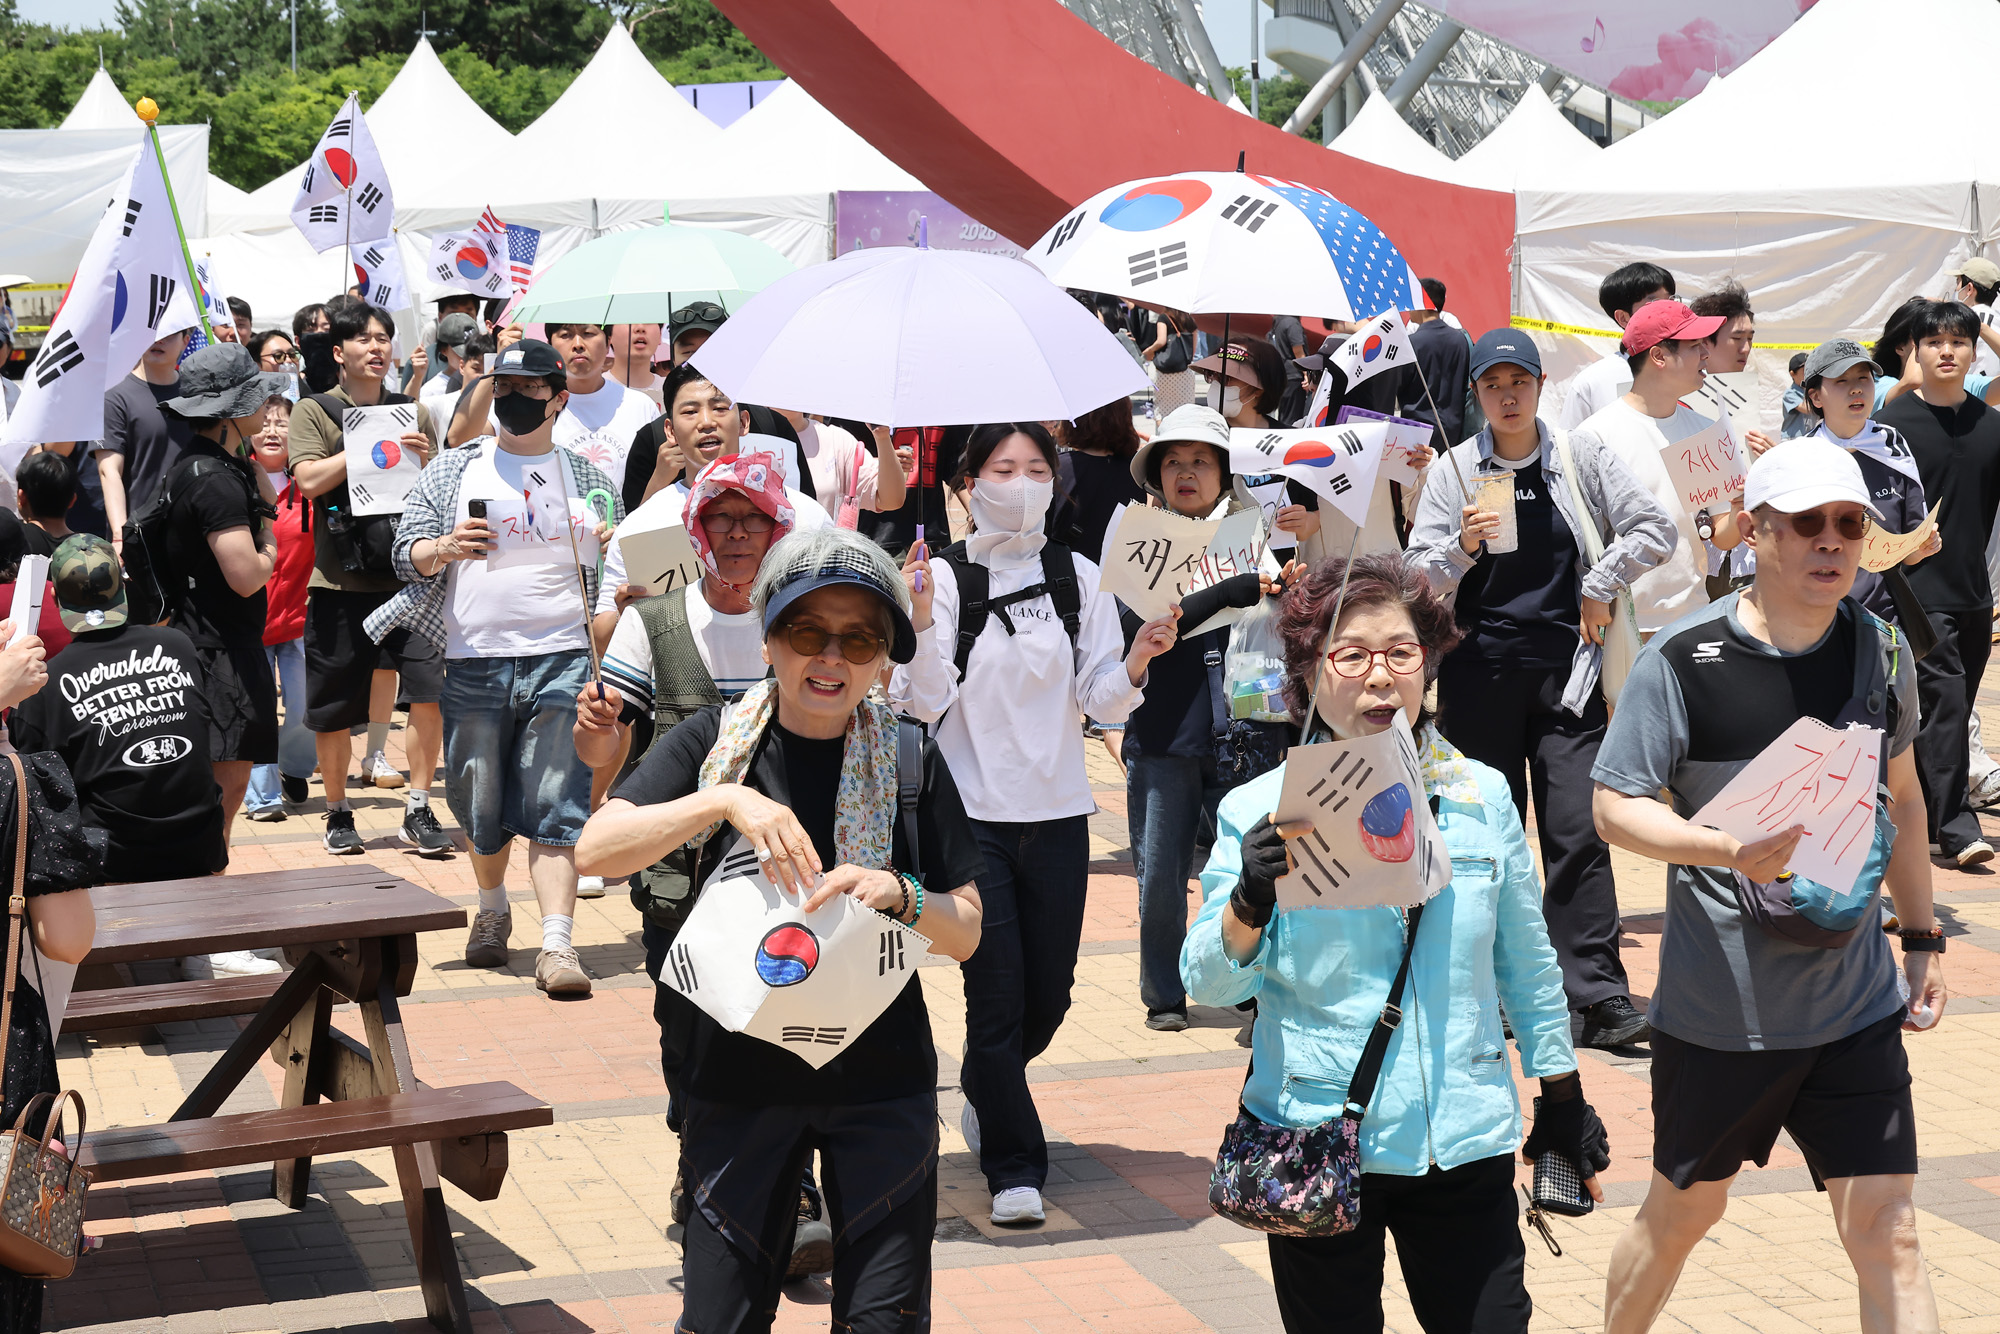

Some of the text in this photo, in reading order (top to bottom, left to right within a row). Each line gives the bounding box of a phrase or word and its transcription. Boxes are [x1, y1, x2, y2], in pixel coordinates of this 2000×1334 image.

[589, 432, 627, 460] CLASSICS
[60, 644, 181, 704] Overwhelm
[71, 671, 195, 722] BETTER FROM
[94, 690, 186, 725] TENACITY
